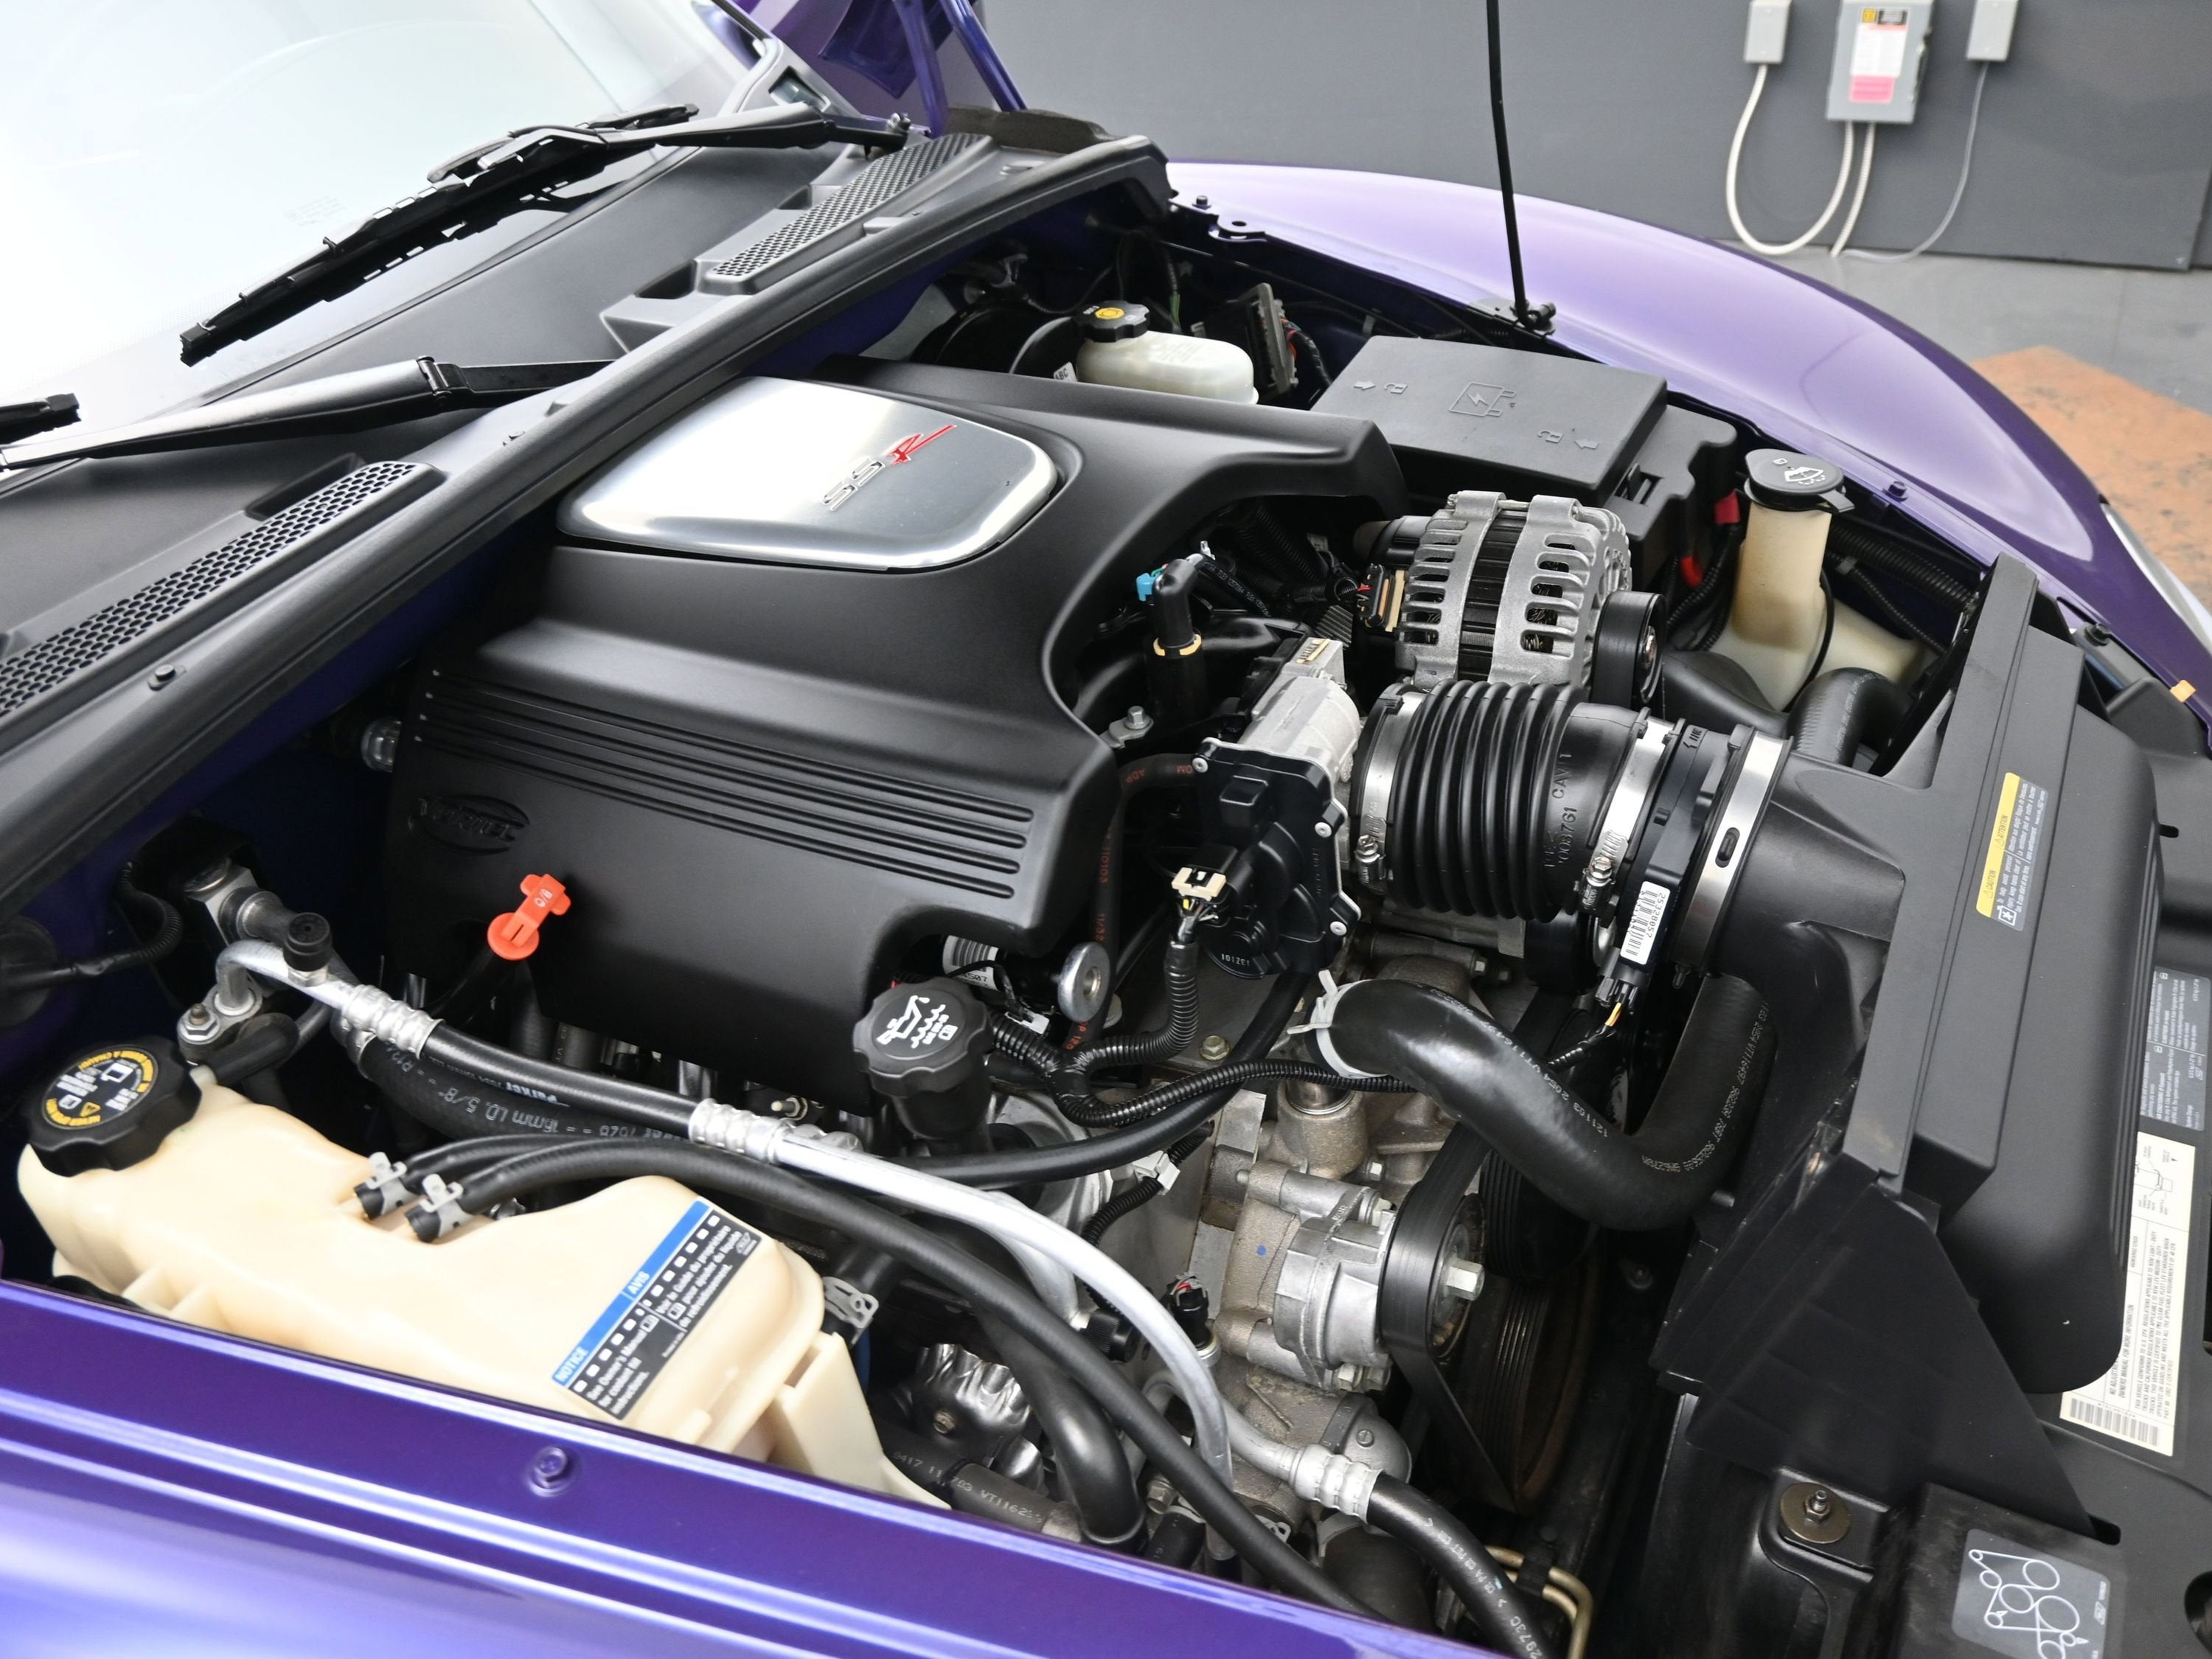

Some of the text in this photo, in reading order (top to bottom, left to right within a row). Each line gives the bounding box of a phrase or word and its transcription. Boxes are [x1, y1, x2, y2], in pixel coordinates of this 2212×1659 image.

[821, 424, 956, 511] SSR
[1997, 813, 2008, 838] ATTENTION
[1985, 869, 1995, 890] CAUTION
[1645, 892, 1666, 938] 25328057
[503, 1080, 558, 1105] Parker
[627, 1271, 650, 1294] AVIS
[555, 1347, 587, 1381] NOTICE
[587, 1329, 647, 1400] See Owner's Manual
[609, 1368, 633, 1396] coolant
